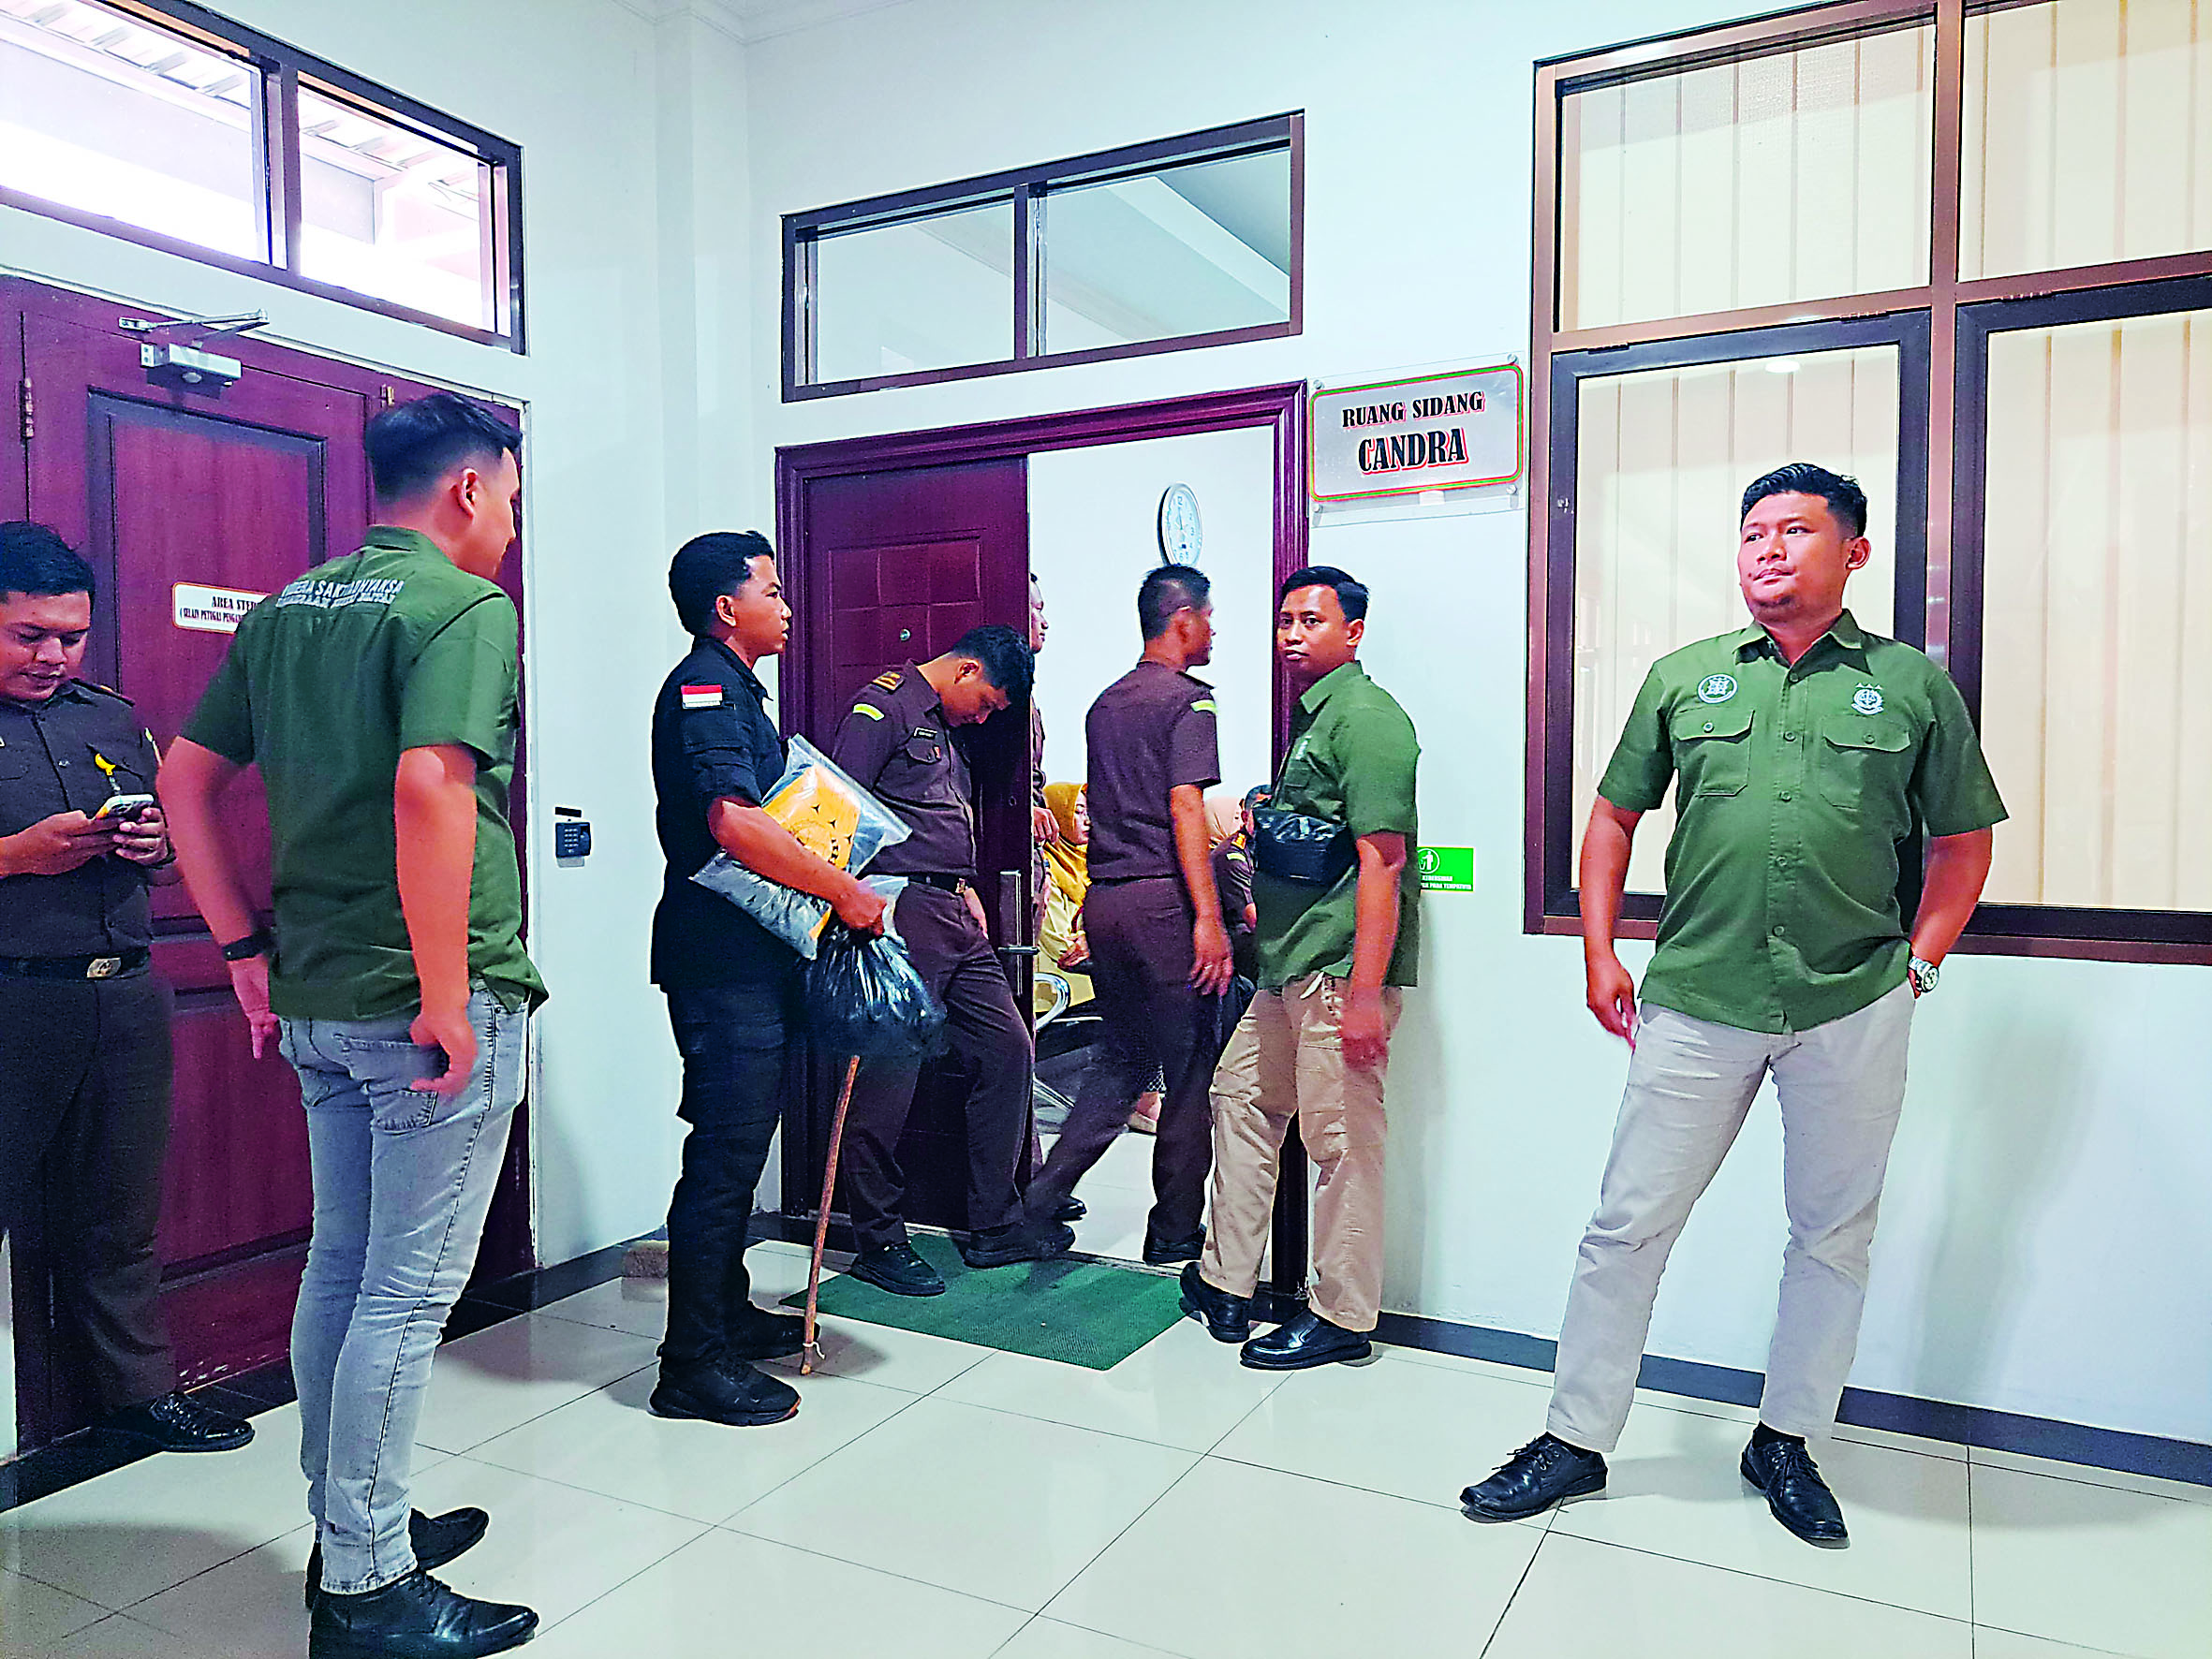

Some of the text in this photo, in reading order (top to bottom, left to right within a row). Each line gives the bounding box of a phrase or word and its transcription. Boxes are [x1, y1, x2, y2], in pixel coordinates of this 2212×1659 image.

[1342, 391, 1484, 428] RUANG SIDANG
[1358, 427, 1468, 475] CANDRA
[212, 595, 234, 609] AREA
